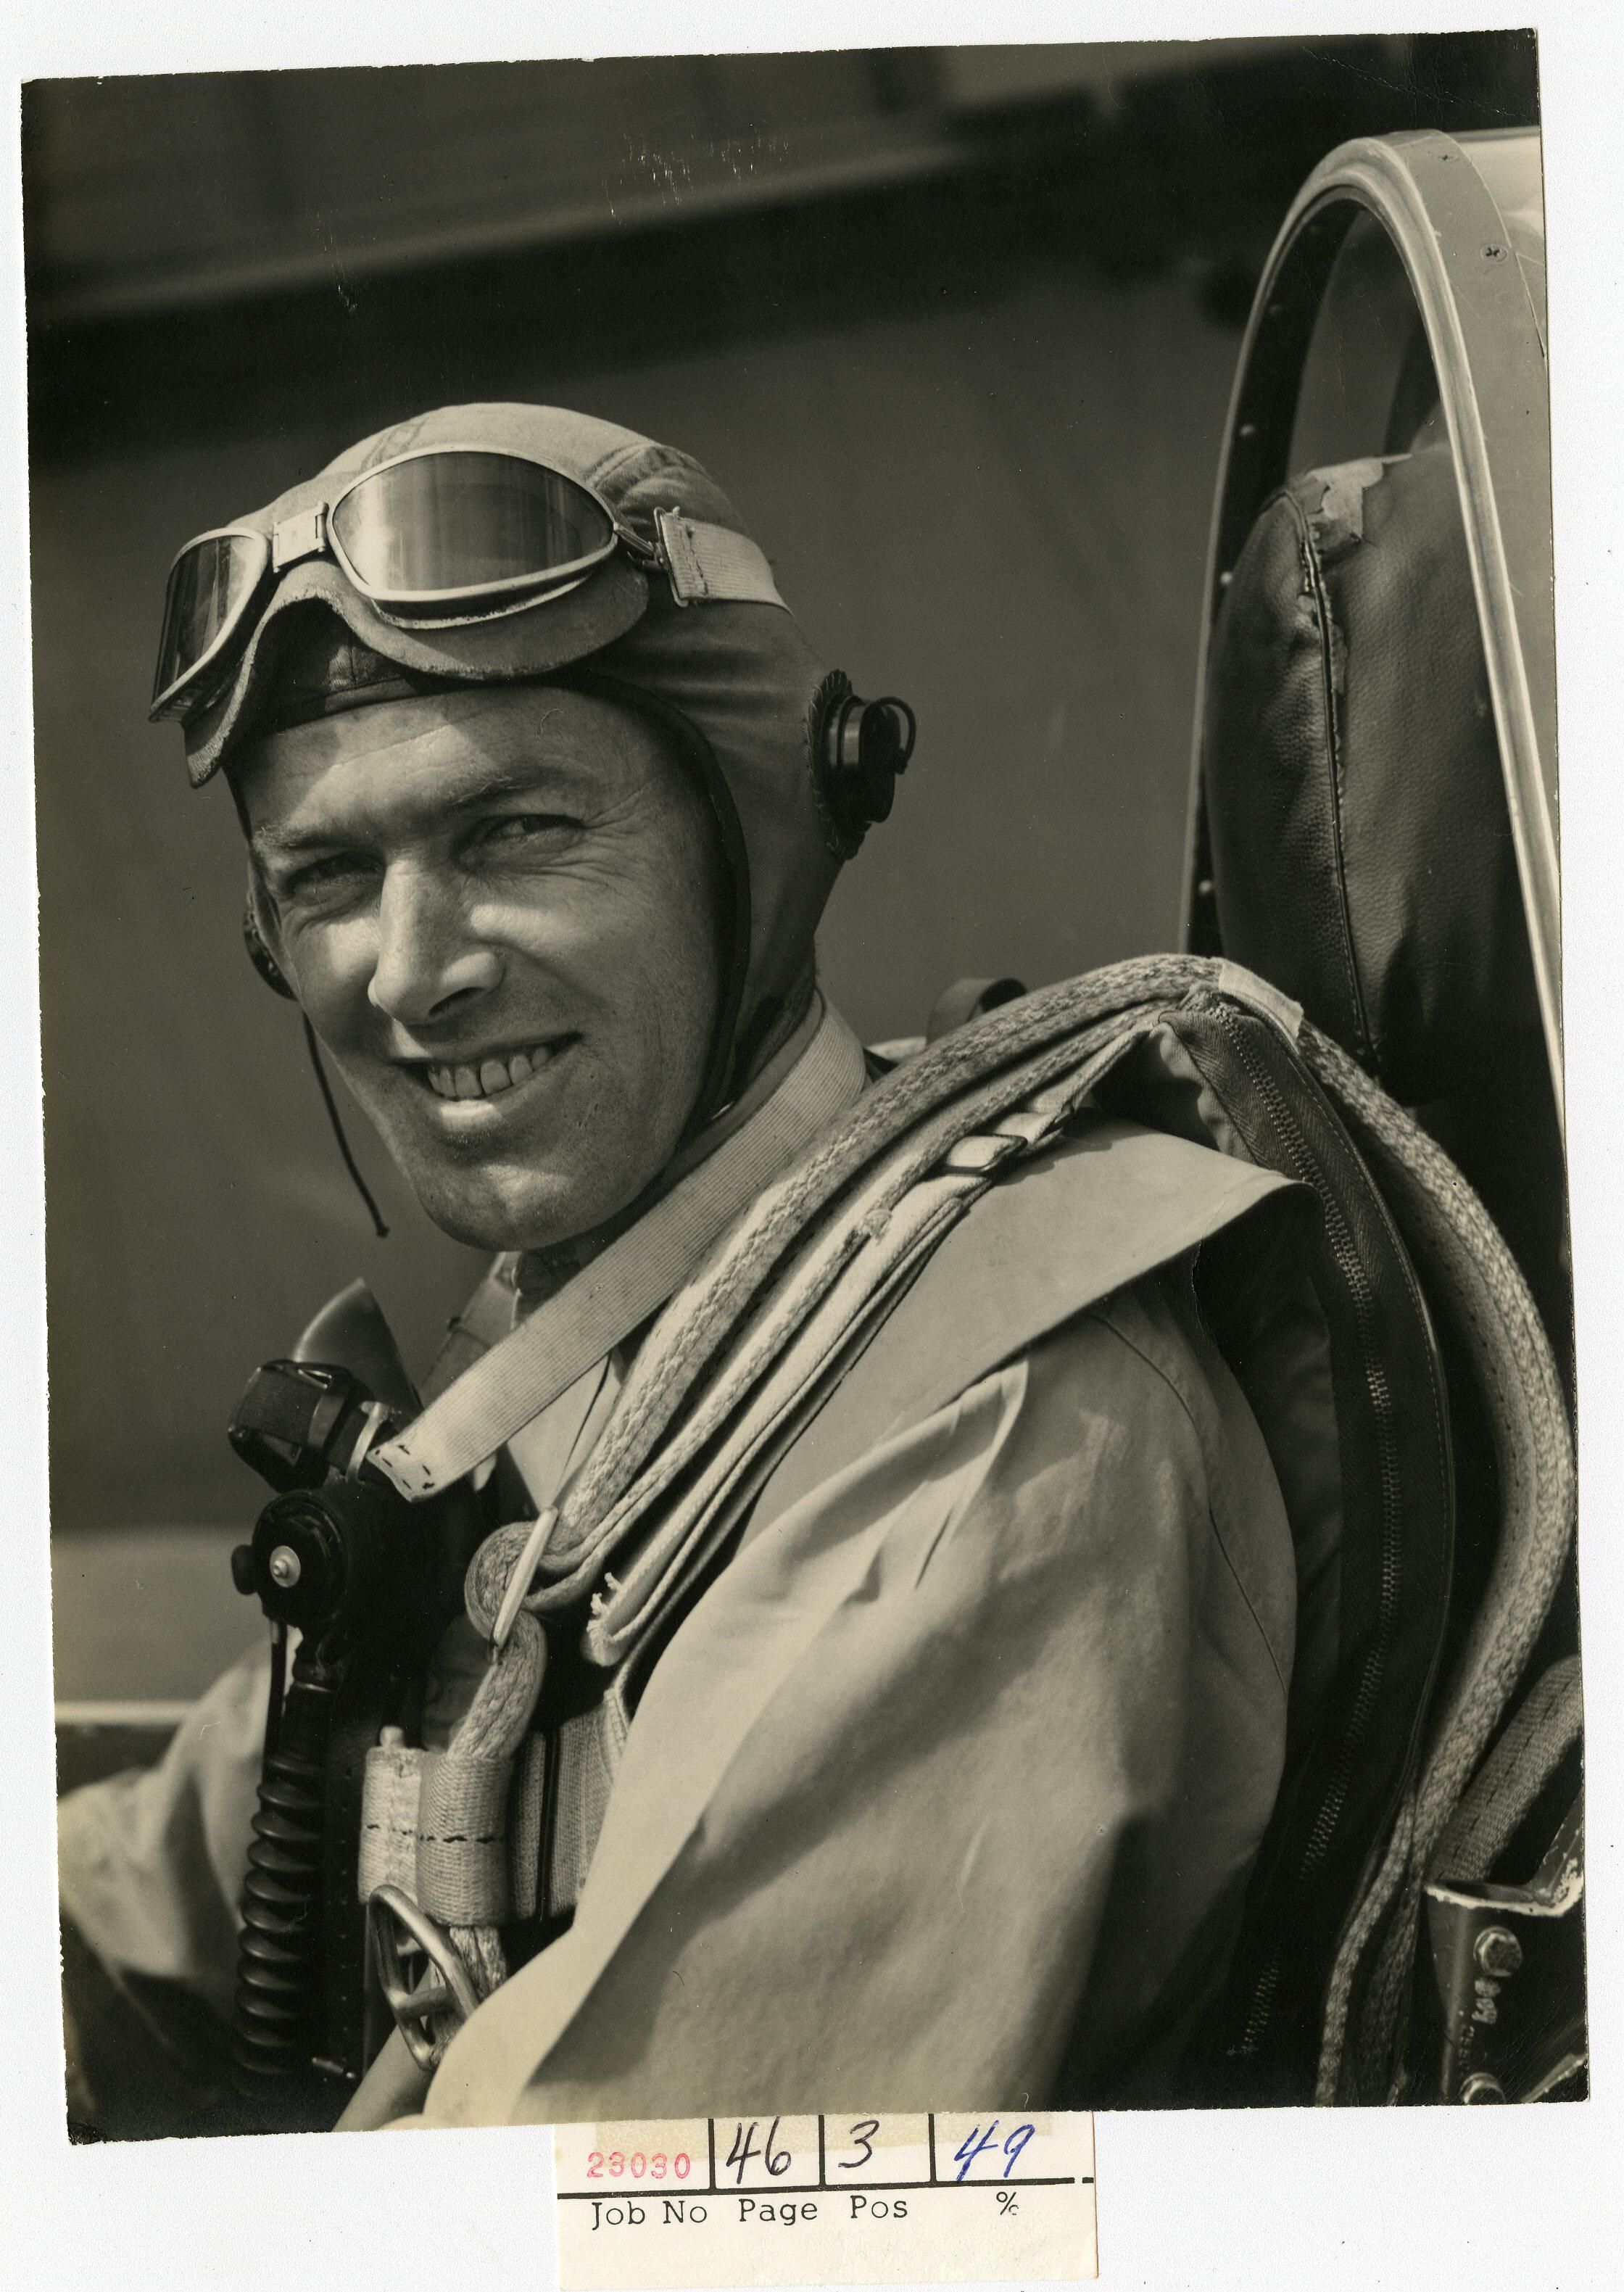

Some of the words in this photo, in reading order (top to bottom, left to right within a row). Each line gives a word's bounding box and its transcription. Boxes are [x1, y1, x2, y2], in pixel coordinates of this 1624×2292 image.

[726, 2116, 792, 2184] 46
[839, 2119, 879, 2169] 3
[953, 2119, 1035, 2183] 49
[587, 2151, 691, 2180] 23030
[592, 2201, 646, 2231] Job
[663, 2200, 708, 2225] No
[738, 2198, 818, 2226] Page
[850, 2193, 908, 2219] Pos
[996, 2191, 1019, 2216] %
